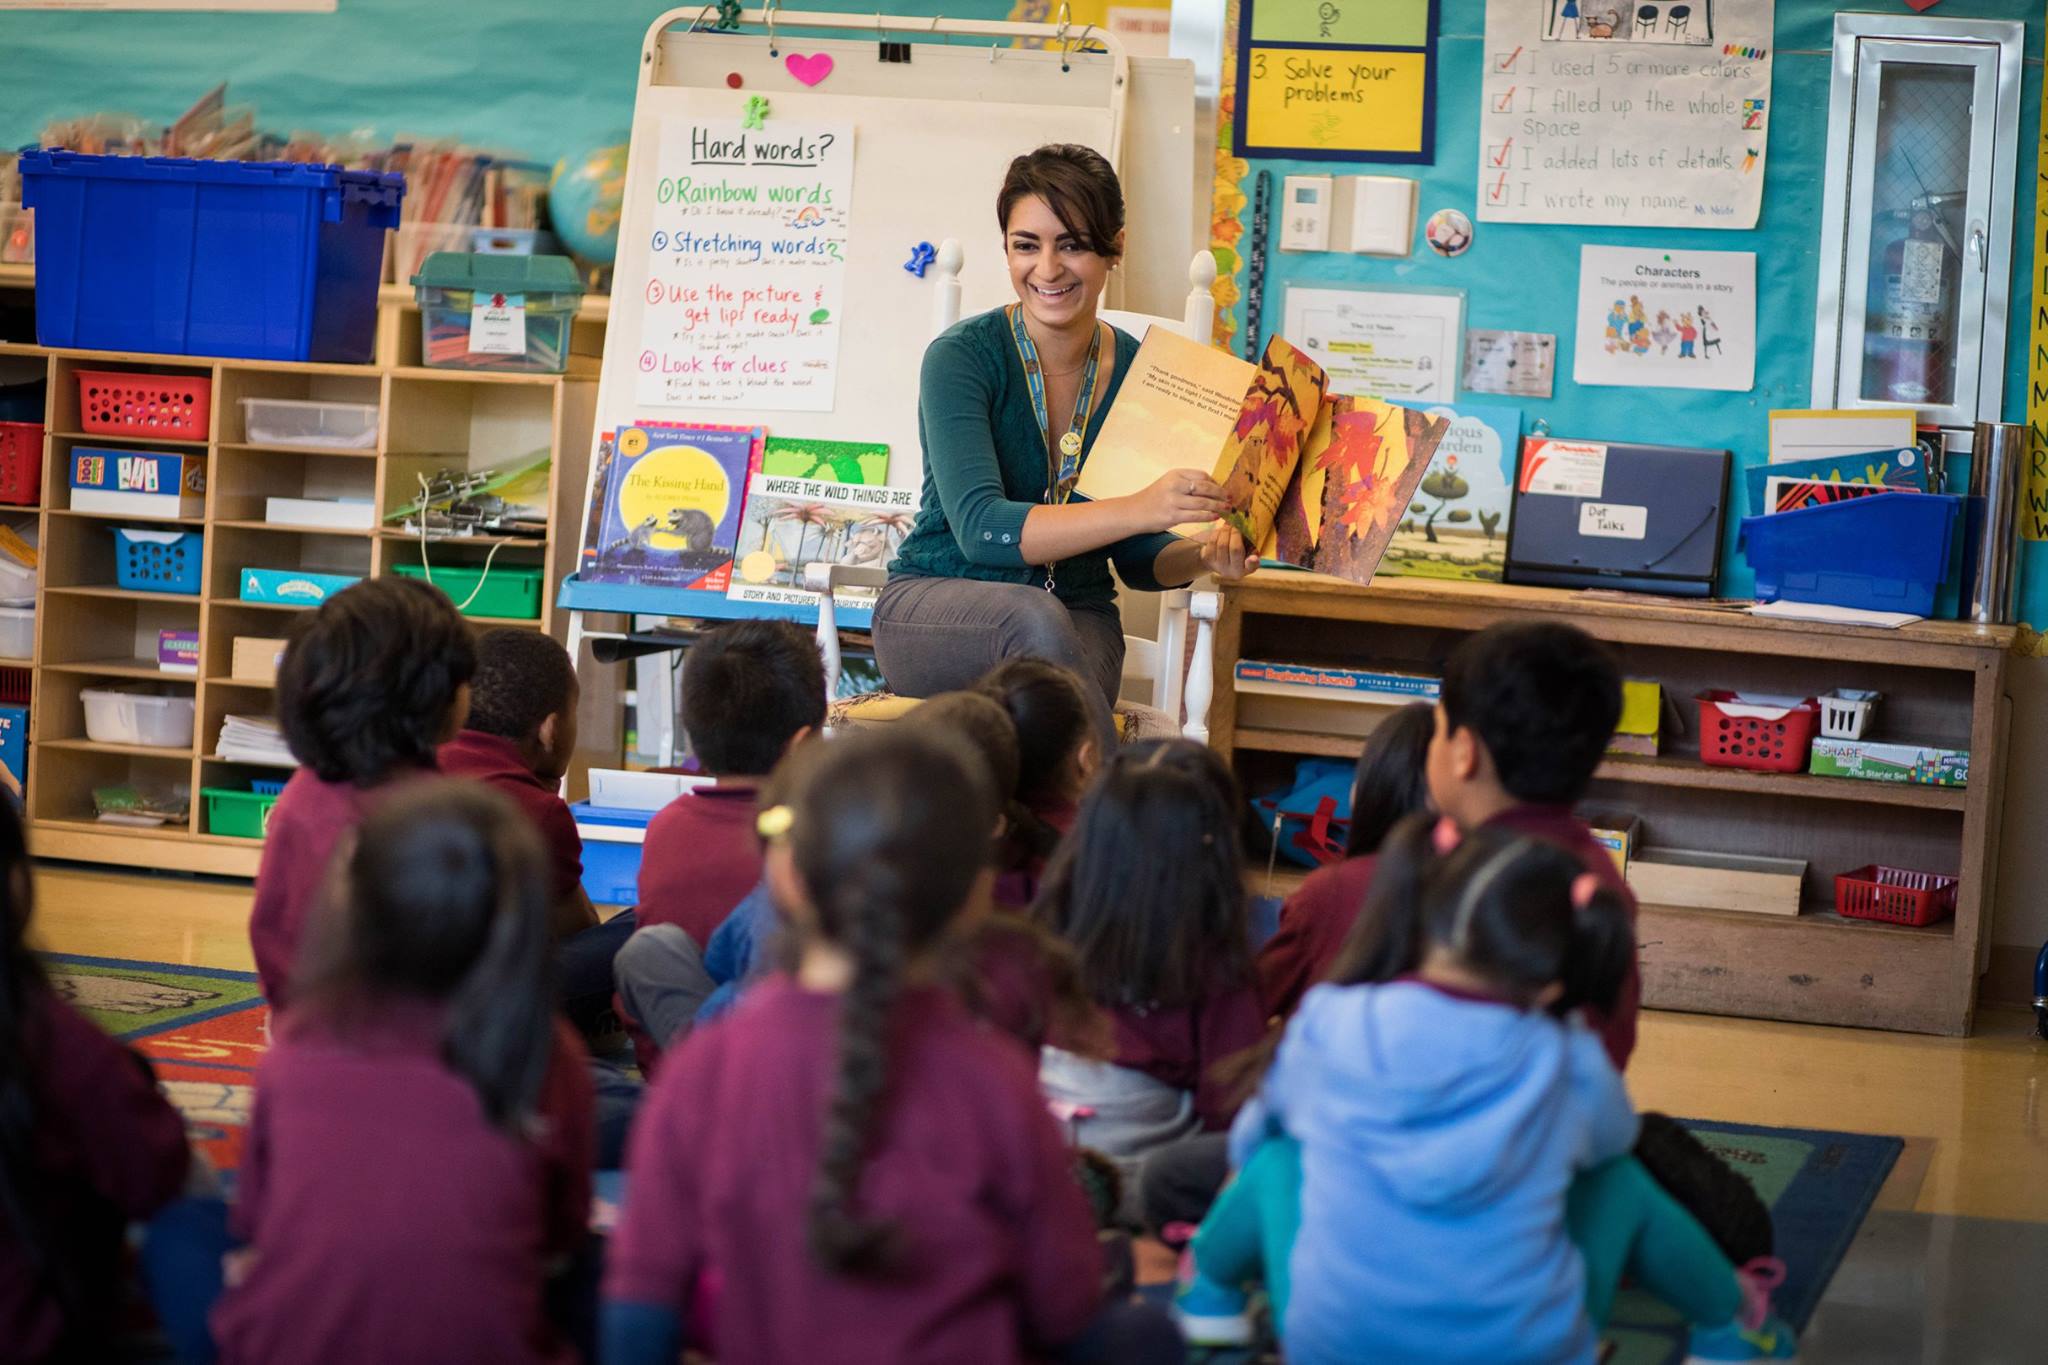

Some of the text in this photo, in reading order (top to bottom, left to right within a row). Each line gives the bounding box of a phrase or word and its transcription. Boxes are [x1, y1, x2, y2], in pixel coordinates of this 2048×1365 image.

[1253, 54, 1397, 89] 3 Solve your
[1528, 50, 1750, 78] I used 5 or more colors
[1283, 81, 1364, 109] problems
[1524, 87, 1737, 120] I filled up the whole
[692, 127, 834, 161] Hard words?
[1523, 147, 1535, 170] I
[1544, 148, 1598, 169] added
[1611, 149, 1638, 168] lots
[1648, 149, 1664, 167] of
[677, 176, 757, 204] Rainbow
[769, 183, 832, 204] words
[1520, 183, 1532, 206] I
[1545, 186, 1594, 209] wrote
[1604, 194, 1630, 215] my
[1641, 193, 1688, 210] name
[672, 231, 761, 262] Stretching
[772, 236, 825, 254] words
[1635, 265, 1700, 278] Characters
[669, 285, 698, 303] Use
[707, 284, 733, 302] the
[743, 285, 802, 309] picture
[1601, 277, 1616, 286] The
[1618, 279, 1648, 288] people
[1661, 280, 1693, 289] animals
[1713, 283, 1733, 293] story
[683, 307, 800, 332] get lips ready
[662, 353, 704, 373] Look
[712, 354, 734, 373] for
[742, 355, 788, 374] clues
[629, 475, 725, 492] The Kissing Hand
[766, 479, 912, 505] WHERE THE WILD THINGS ARE
[1597, 519, 1625, 531] Talks
[743, 589, 764, 599] STORY
[766, 591, 781, 601] AND
[783, 593, 816, 606] PICTURES
[1265, 667, 1317, 684] Beginning
[1318, 672, 1356, 688] Sounds
[1820, 745, 1862, 757] SHAPE
[1851, 769, 1908, 780] The Starter Set
